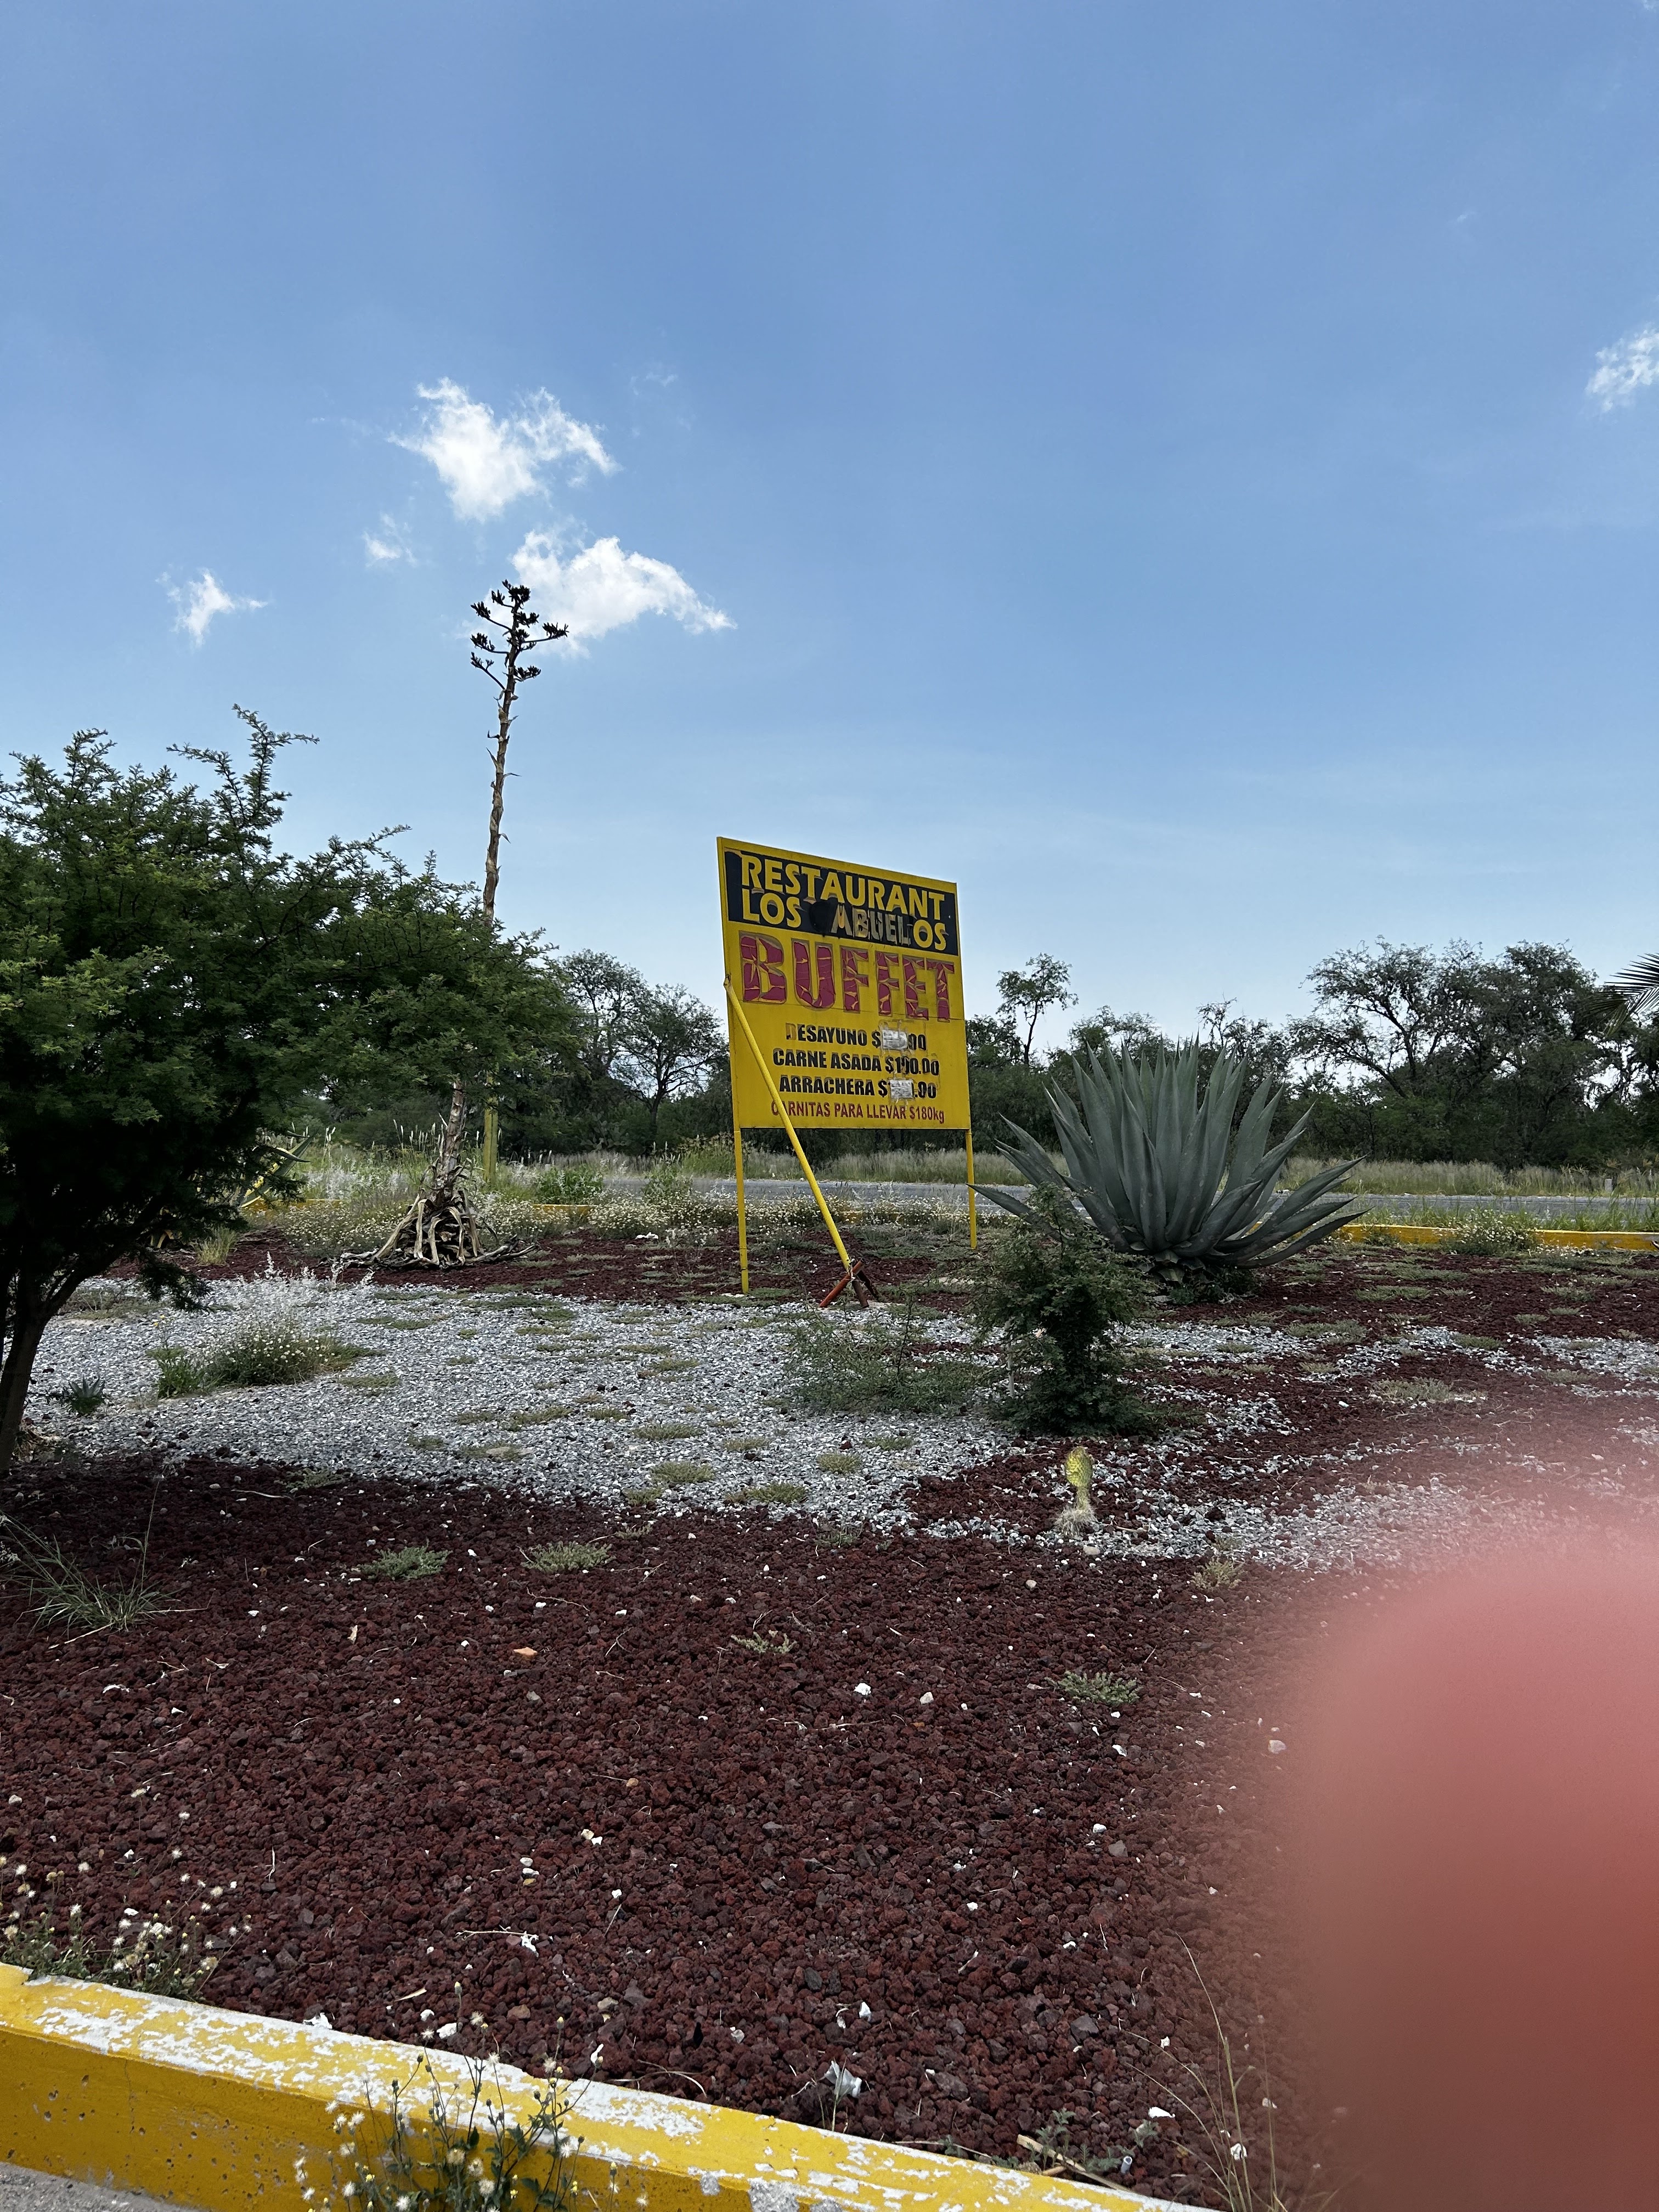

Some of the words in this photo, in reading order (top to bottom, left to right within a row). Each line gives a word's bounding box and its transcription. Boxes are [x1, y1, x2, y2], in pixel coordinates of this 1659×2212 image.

[742, 854, 945, 921] RESTAURANT
[742, 888, 802, 928] LOS
[831, 902, 947, 951] ABUELOS
[739, 931, 955, 1023] BUFFET
[773, 1048, 827, 1069] CARNE
[831, 1052, 882, 1072] ASADA
[780, 1075, 875, 1096] ARRACHERA
[834, 1102, 864, 1118] PARA
[867, 1104, 906, 1120] LLEVAR
